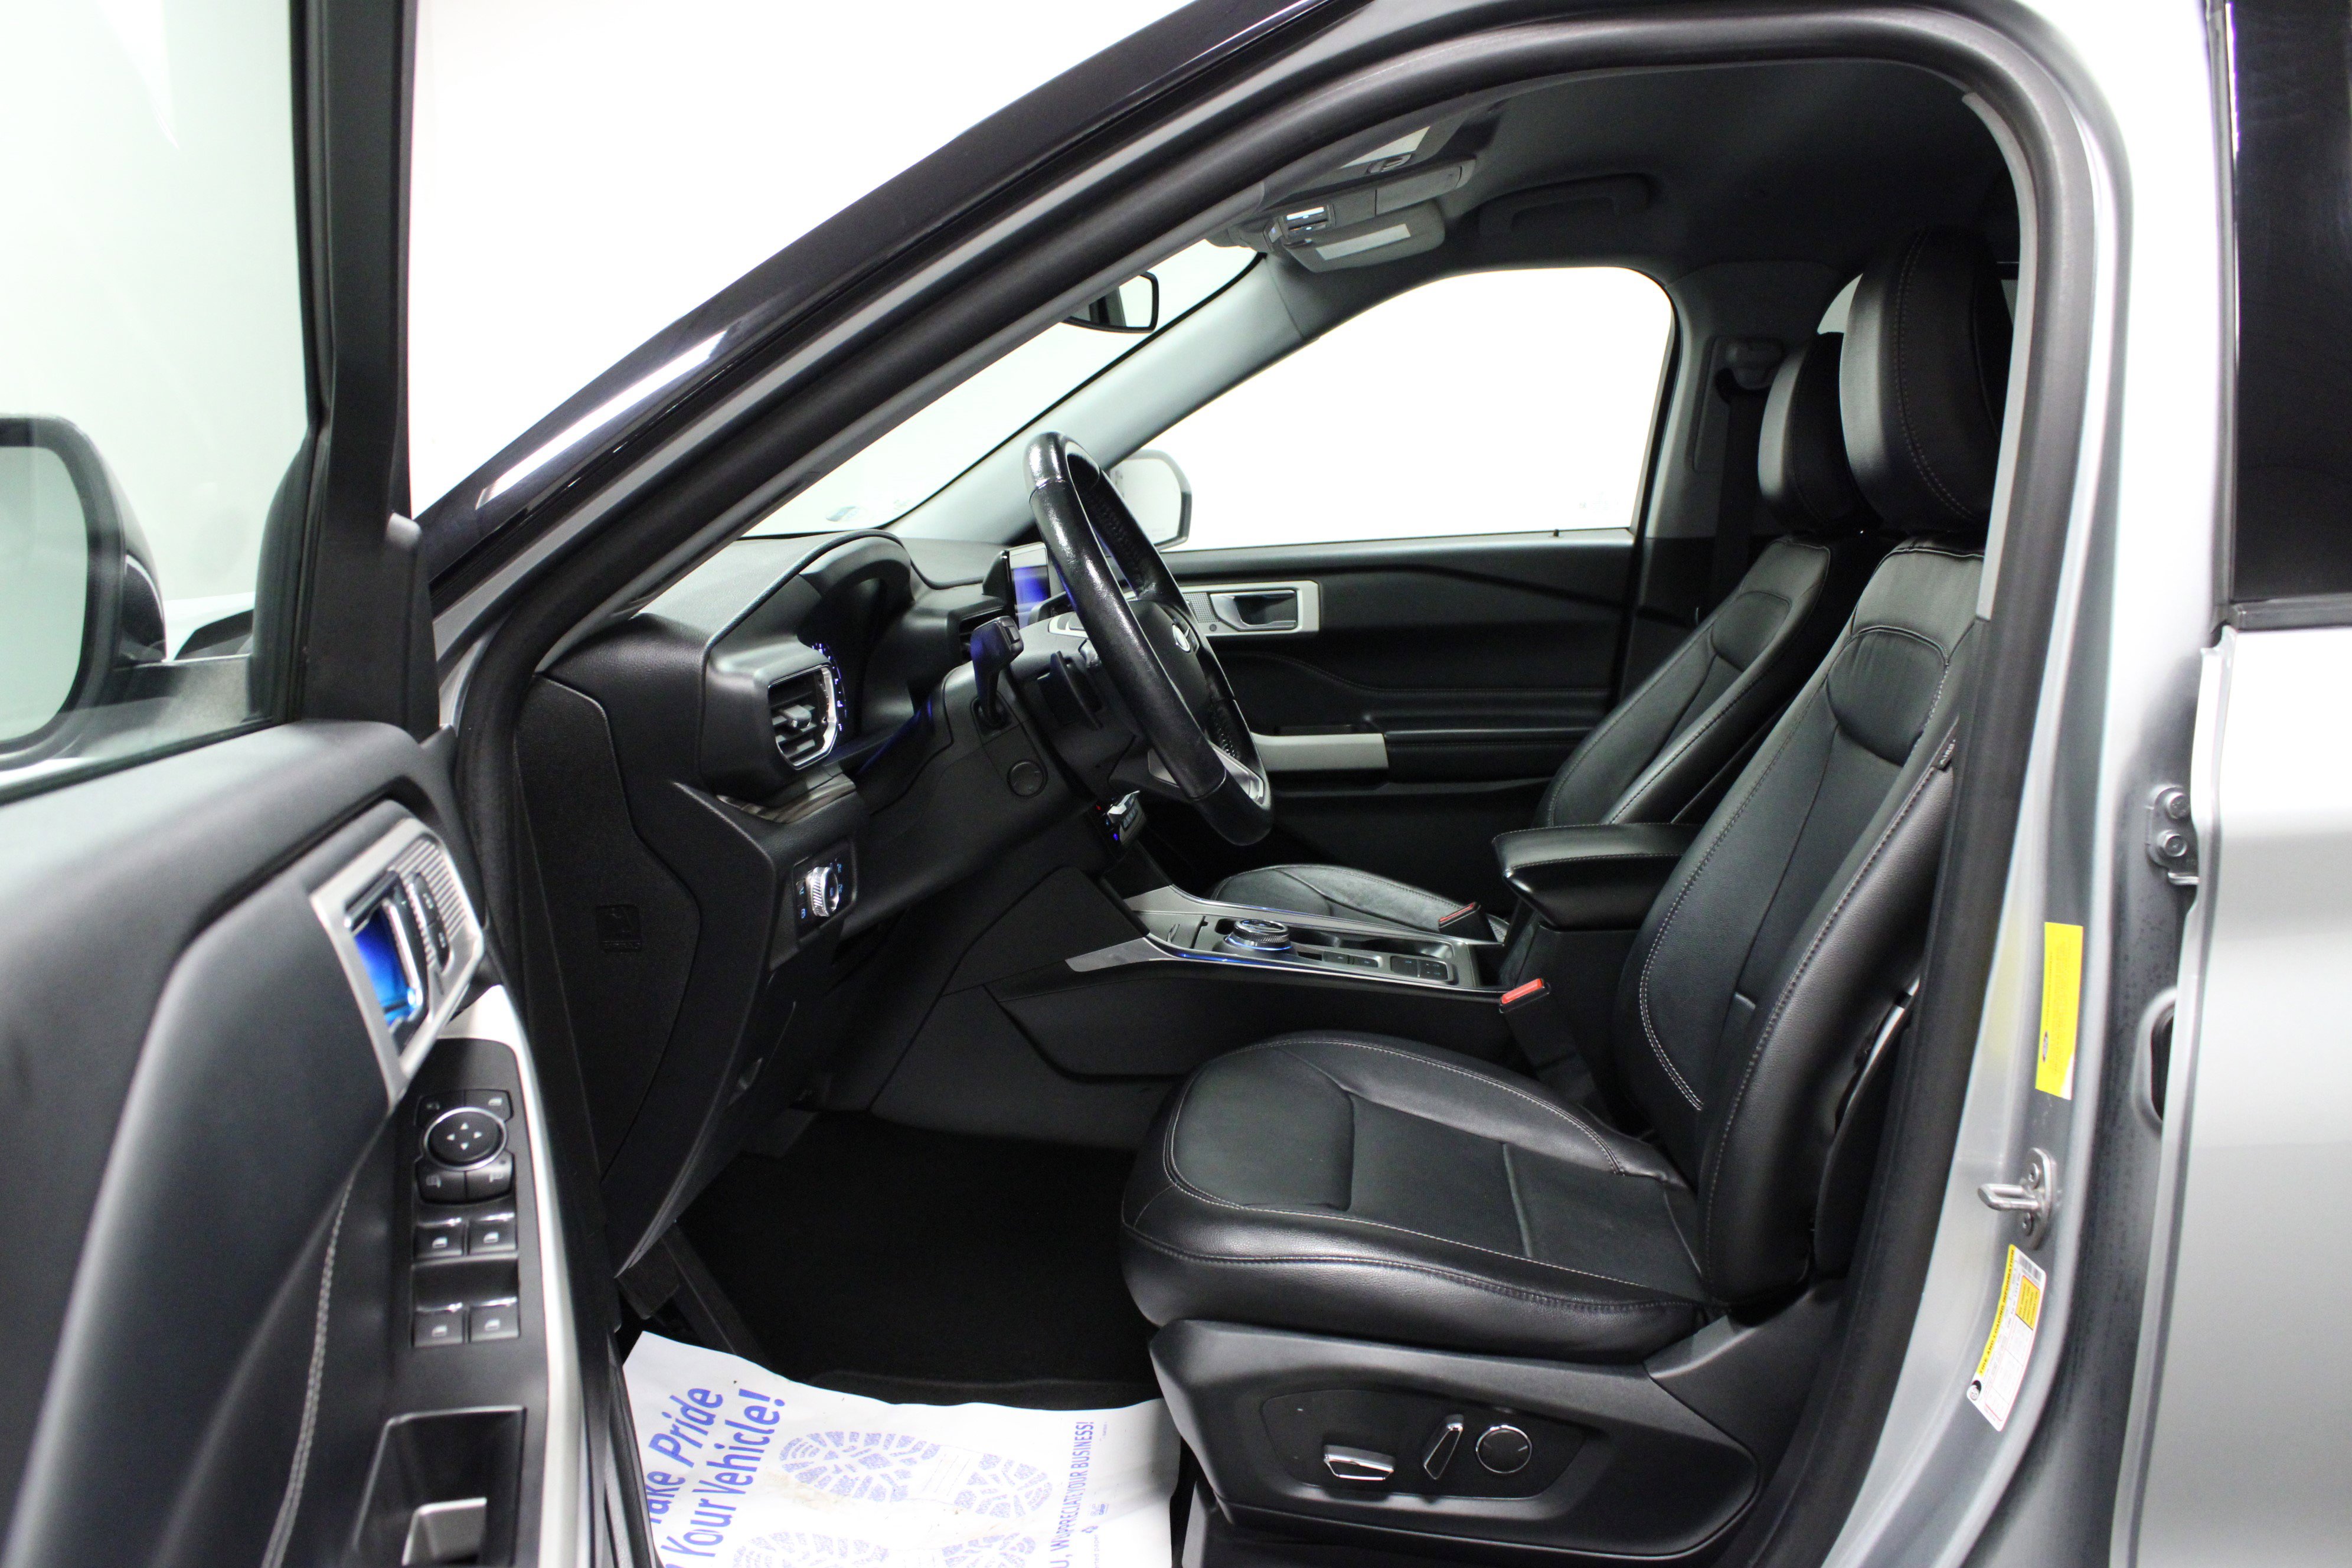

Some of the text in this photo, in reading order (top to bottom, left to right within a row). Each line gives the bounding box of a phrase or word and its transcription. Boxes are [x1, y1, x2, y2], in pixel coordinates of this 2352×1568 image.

[648, 1388, 723, 1468] Pride
[1070, 1422, 1095, 1469] BUSINESS!
[645, 1471, 686, 1524] ake
[660, 1388, 785, 1557] Your Vehicle!
[1066, 1470, 1088, 1492] YOUR
[1056, 1491, 1084, 1537] PPRECIATE
